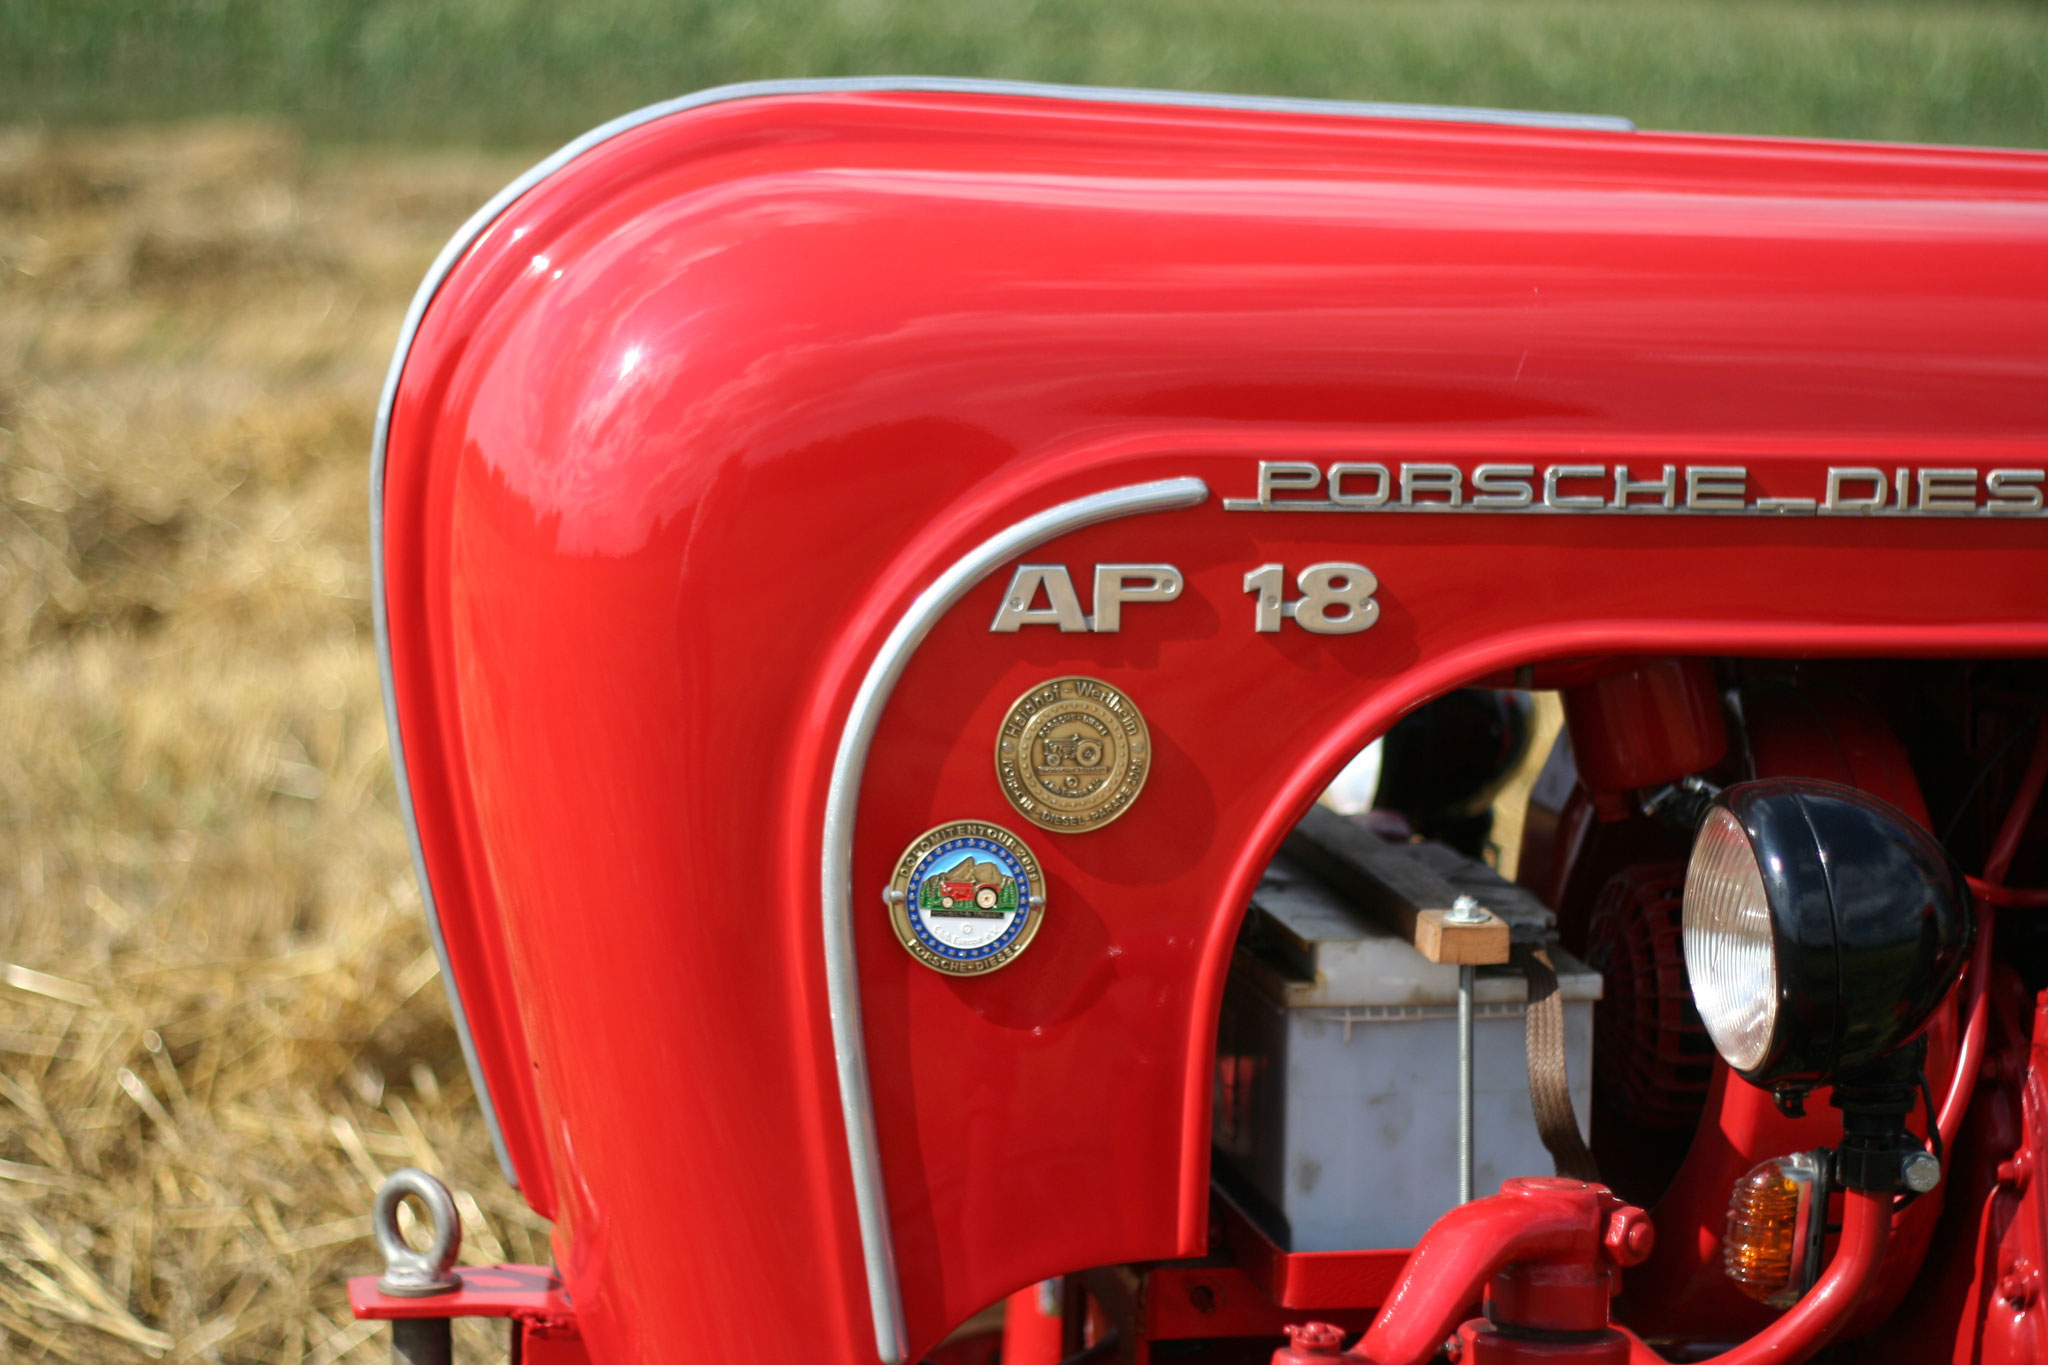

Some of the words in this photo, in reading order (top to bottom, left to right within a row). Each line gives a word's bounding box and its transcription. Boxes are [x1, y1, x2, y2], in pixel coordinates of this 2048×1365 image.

[1257, 460, 1748, 513] PORSCHE
[1826, 465, 2046, 513] DIES
[988, 563, 1184, 632] AP
[1243, 562, 1380, 634] 18
[1074, 680, 1138, 736] Wertheim
[900, 824, 1018, 878] DOLOMITENTOUR
